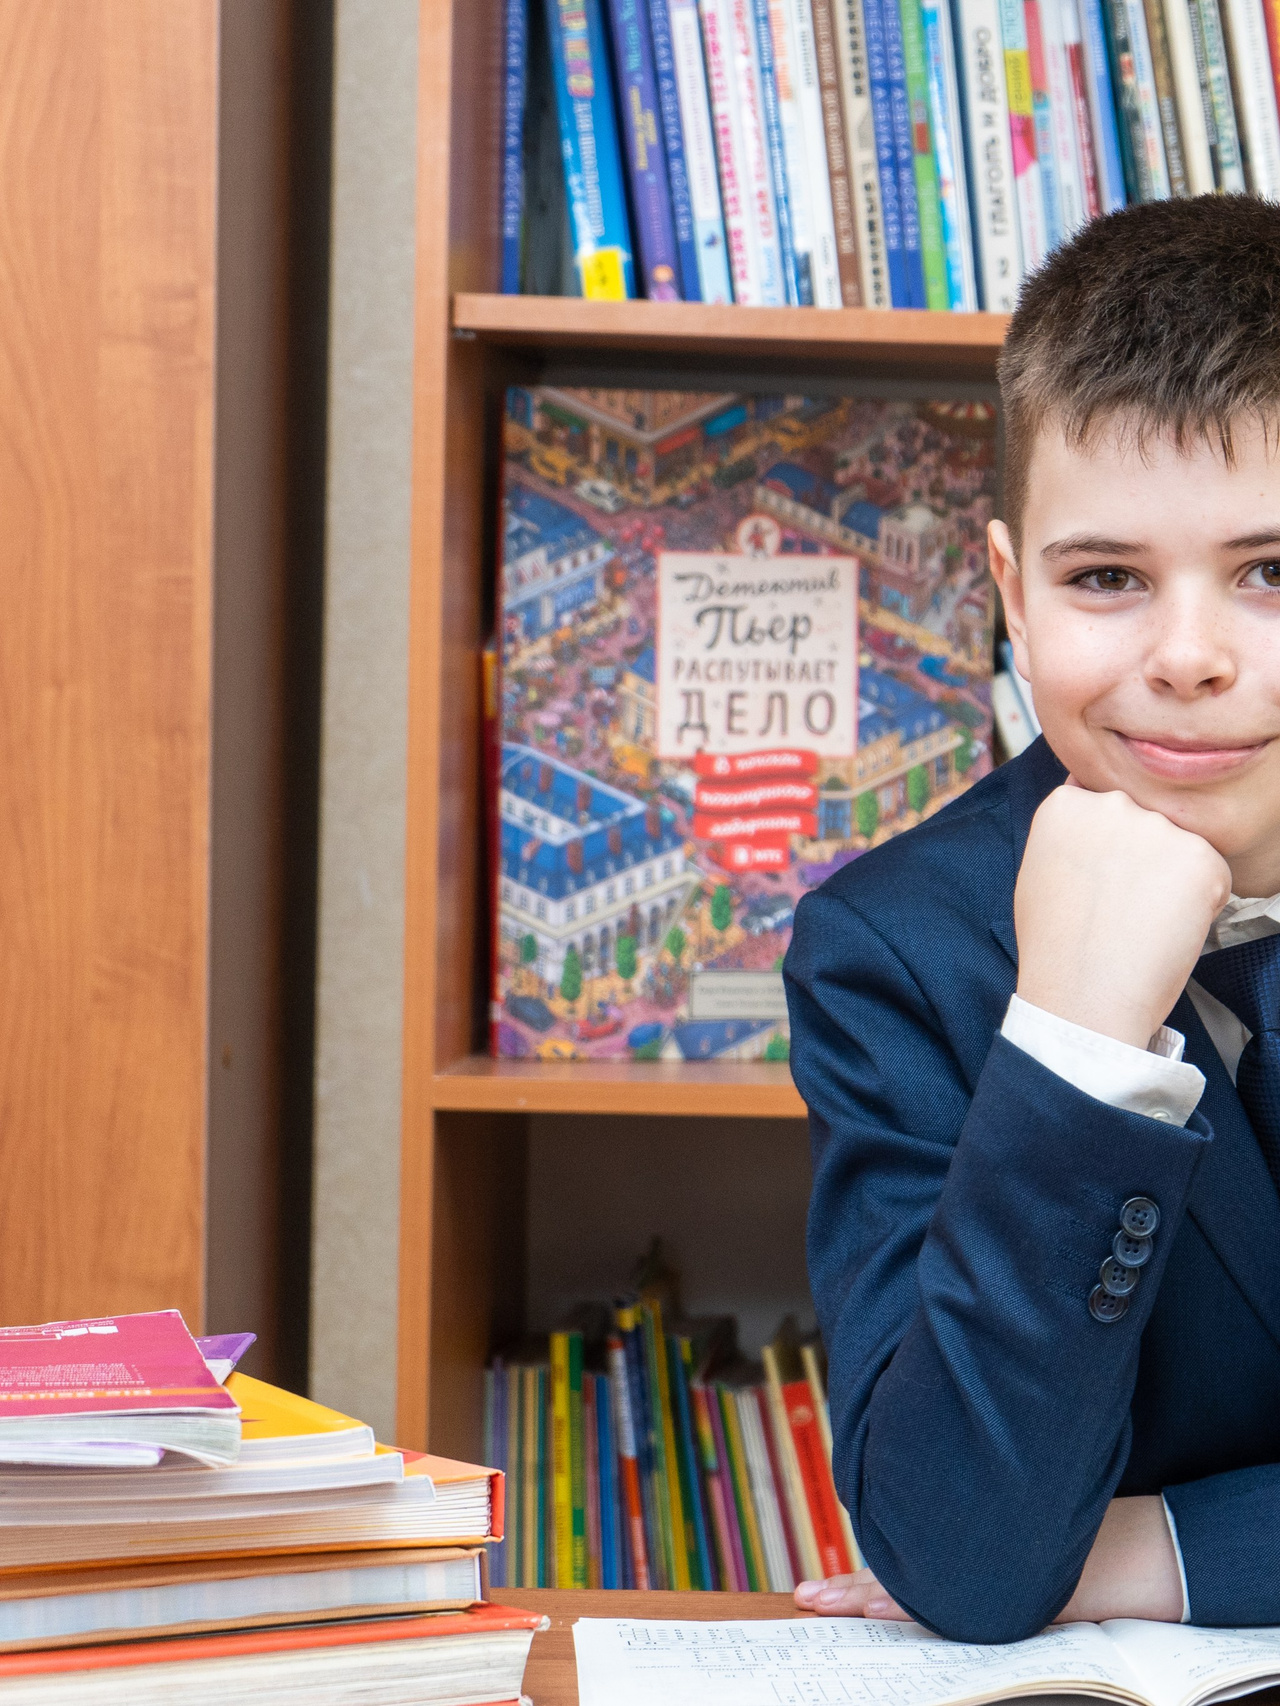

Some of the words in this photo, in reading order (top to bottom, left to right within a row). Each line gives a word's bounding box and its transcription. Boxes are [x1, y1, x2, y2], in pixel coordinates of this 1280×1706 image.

[972, 26, 999, 105] ДОБРО
[505, 74, 522, 148] АЗБУКА
[822, 88, 847, 172] МИРОВОЙ
[875, 87, 895, 160] АЗБУКА
[892, 87, 912, 161] АЗБУКА
[503, 155, 521, 238] МОСКВЫ
[659, 79, 681, 151] АЗБУКА
[671, 159, 692, 242] МОСКВЫ
[834, 175, 856, 254] ИСТОРИЯ
[882, 166, 901, 250] МОСКВЫ
[900, 166, 919, 250] МОСКВЫ
[673, 567, 841, 602] Детектив
[695, 604, 813, 654] Пьер
[672, 658, 839, 683] РАСПУТЫВАЕТ
[676, 688, 837, 745] ДЕЛО
